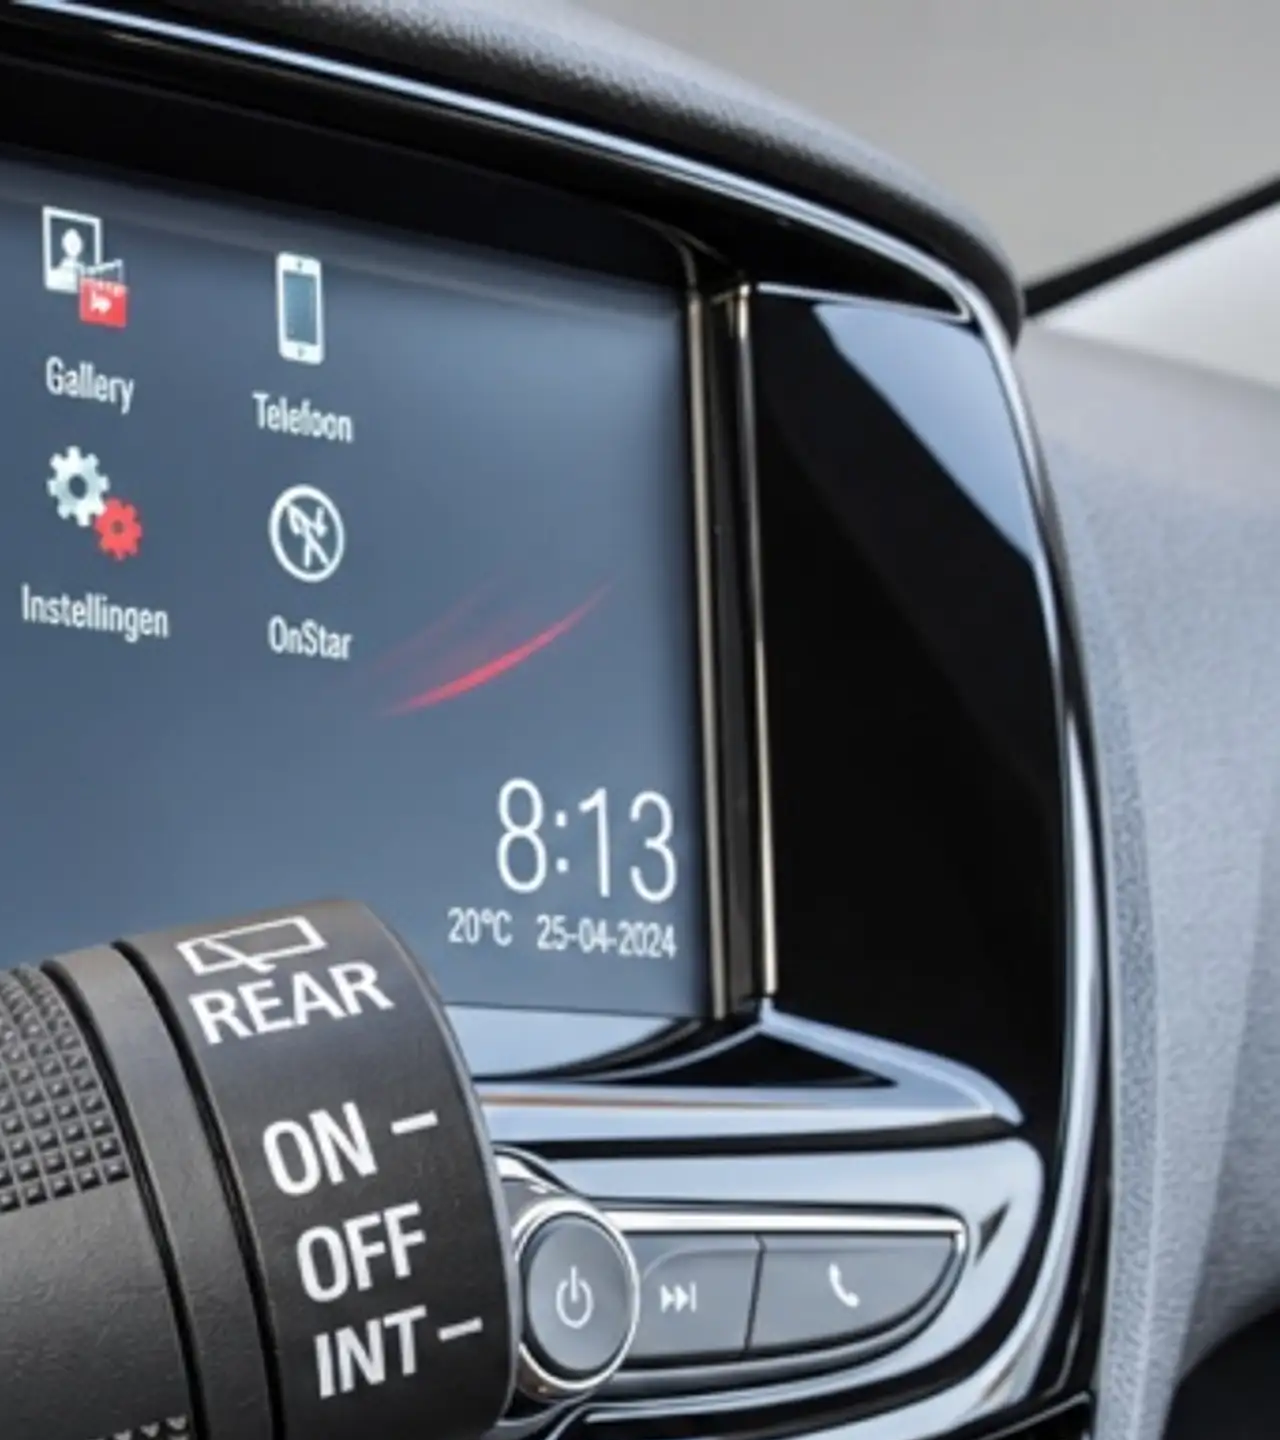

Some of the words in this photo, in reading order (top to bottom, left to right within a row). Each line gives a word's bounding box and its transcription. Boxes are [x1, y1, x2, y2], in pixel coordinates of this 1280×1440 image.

[45, 357, 134, 413] Gallery
[252, 392, 353, 443] Telefoon
[21, 584, 169, 641] Instellingen
[268, 616, 352, 660] OnStar
[496, 777, 678, 903] 8:13
[448, 907, 514, 946] 20°C
[537, 913, 677, 959] 25-04-2024
[188, 960, 394, 1045] REAR
[262, 1102, 378, 1196] ON
[296, 1202, 426, 1302] OFF
[314, 1305, 427, 1398] INT
